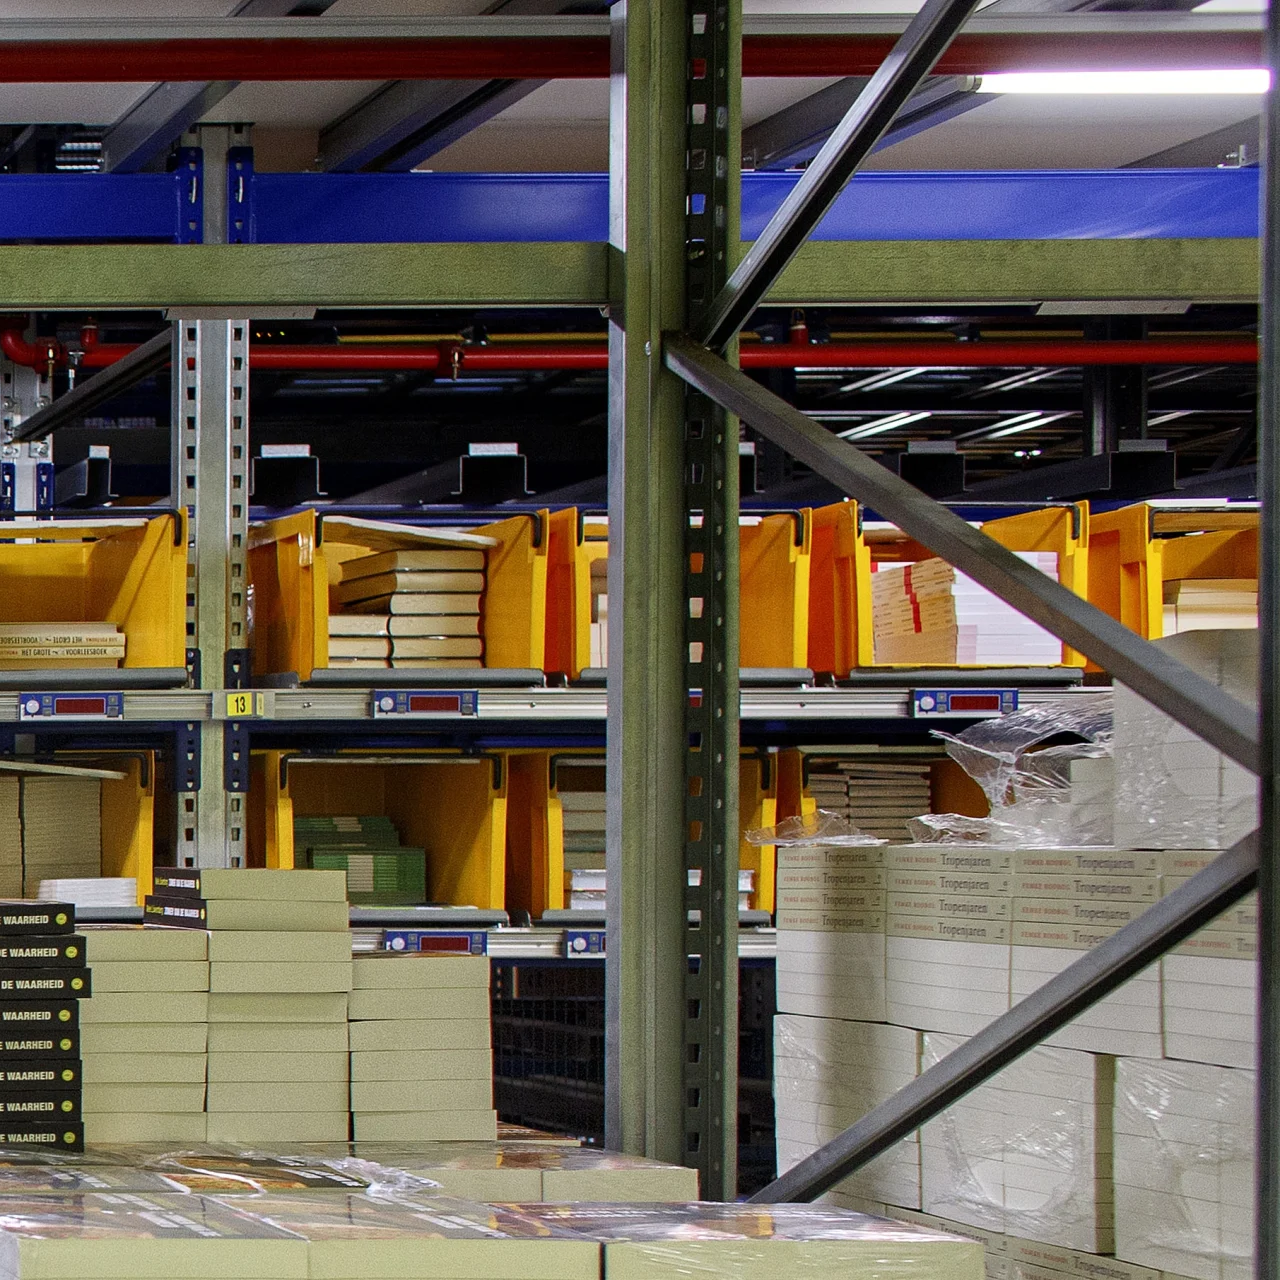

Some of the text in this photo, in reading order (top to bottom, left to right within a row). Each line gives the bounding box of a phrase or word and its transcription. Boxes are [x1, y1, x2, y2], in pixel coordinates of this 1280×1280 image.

[235, 696, 246, 713] 13
[941, 854, 990, 867] Tropenjaren
[940, 877, 989, 891] Tropenjaren
[939, 900, 987, 914] Tropenjaren
[3, 916, 48, 924] WAARHEID
[939, 922, 986, 937] Tropenjaren
[10, 948, 58, 957] WAARHEID
[1, 981, 13, 989] DE
[16, 980, 64, 988] WAARHEID
[3, 1012, 51, 1020] WAARHEID
[5, 1041, 52, 1049] WAARHEID
[7, 1072, 54, 1080] WAARHEID
[7, 1103, 54, 1111] WAARHEID
